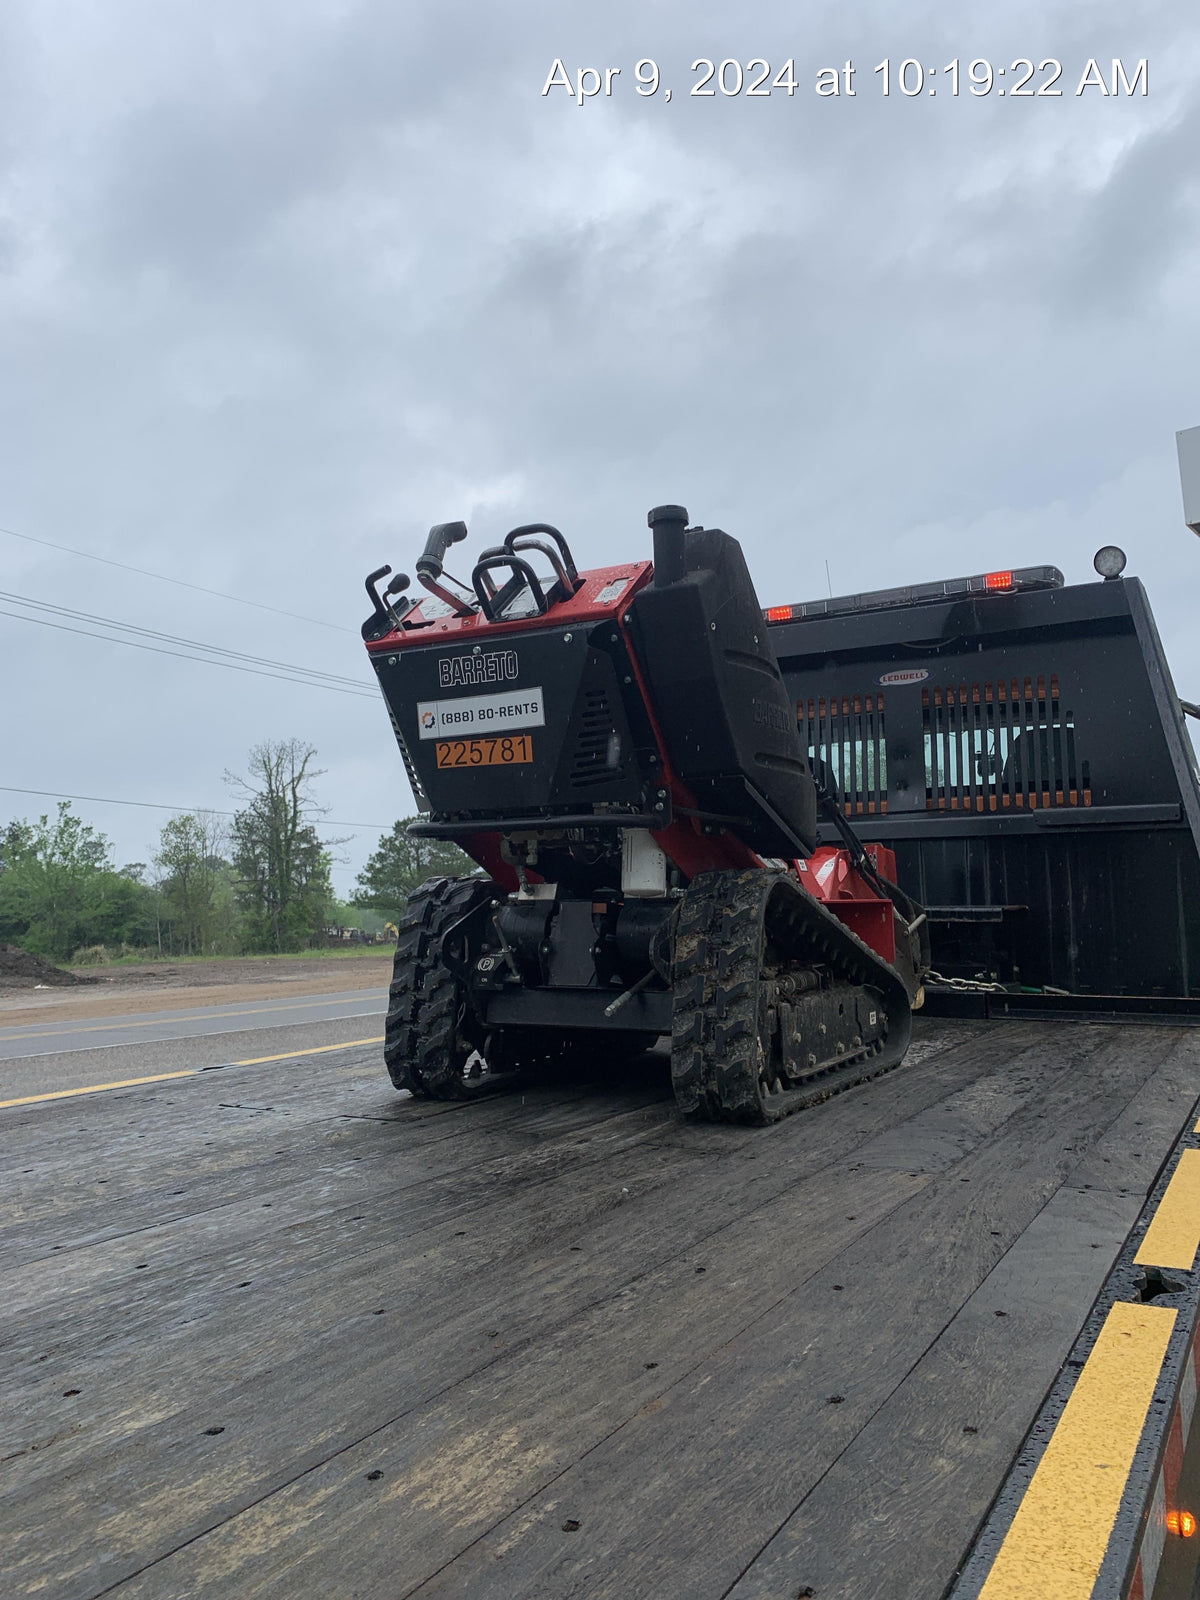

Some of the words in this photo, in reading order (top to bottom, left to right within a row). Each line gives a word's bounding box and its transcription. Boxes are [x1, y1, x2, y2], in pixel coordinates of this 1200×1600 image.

[439, 651, 519, 687] BARRETO
[882, 671, 926, 683] LEDWELL
[441, 709, 474, 725] (888)
[478, 702, 539, 721] 80-RENTS
[438, 737, 527, 767] 225781
